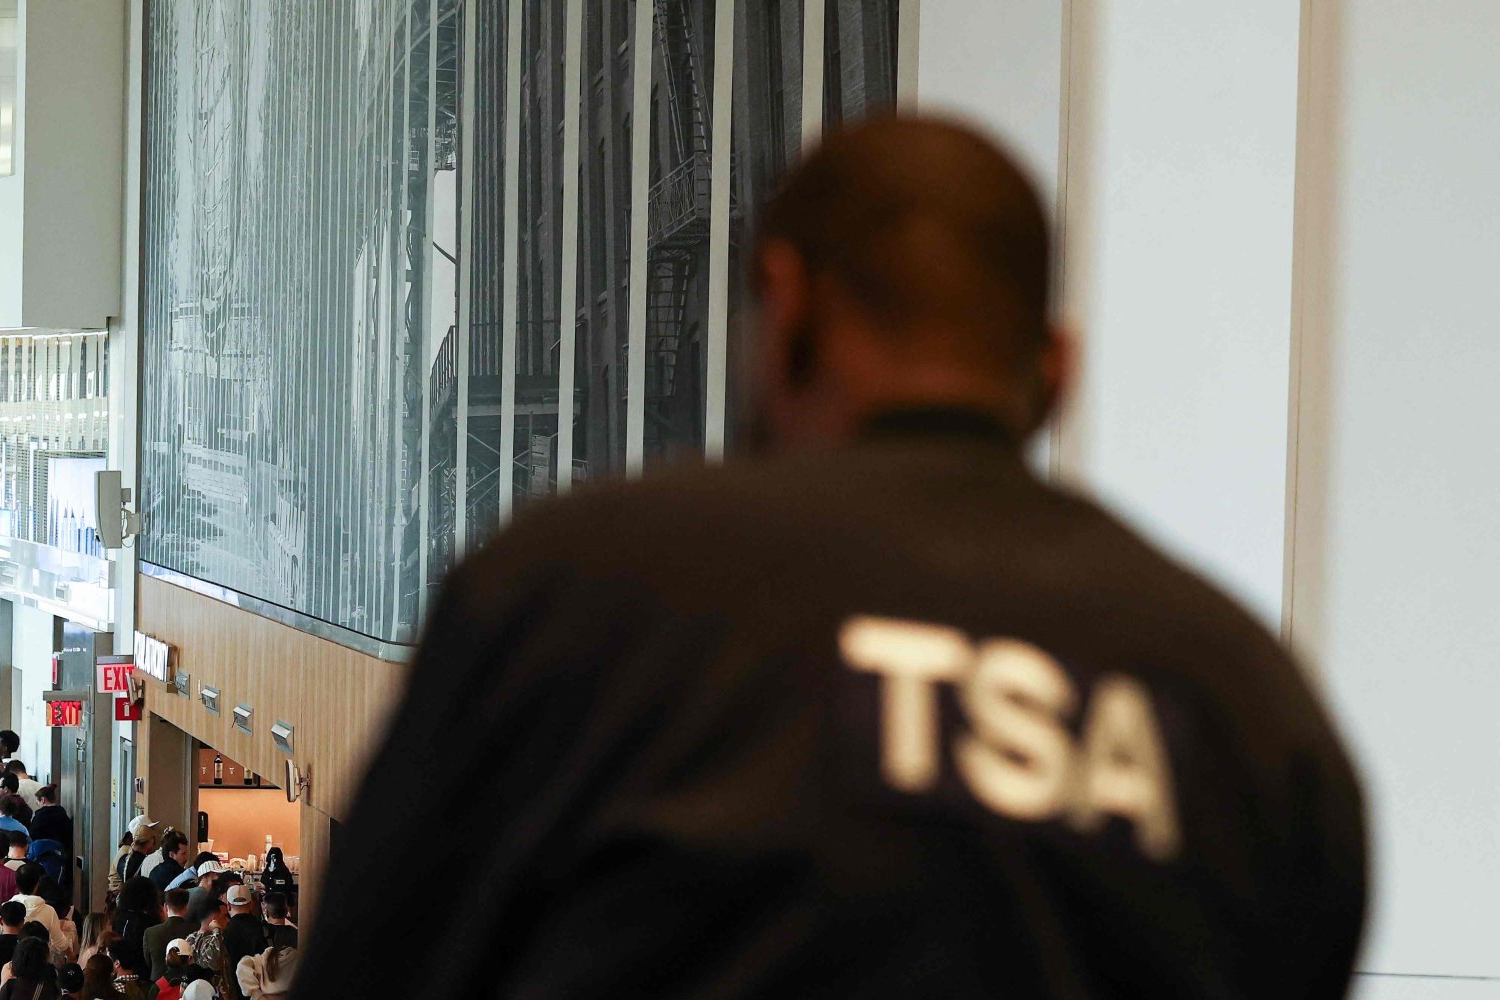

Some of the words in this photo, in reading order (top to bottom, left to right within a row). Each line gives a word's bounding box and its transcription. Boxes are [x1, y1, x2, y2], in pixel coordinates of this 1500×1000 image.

[104, 667, 134, 690] EXIT
[52, 700, 82, 725] EXIT
[838, 613, 1182, 862] TSA
